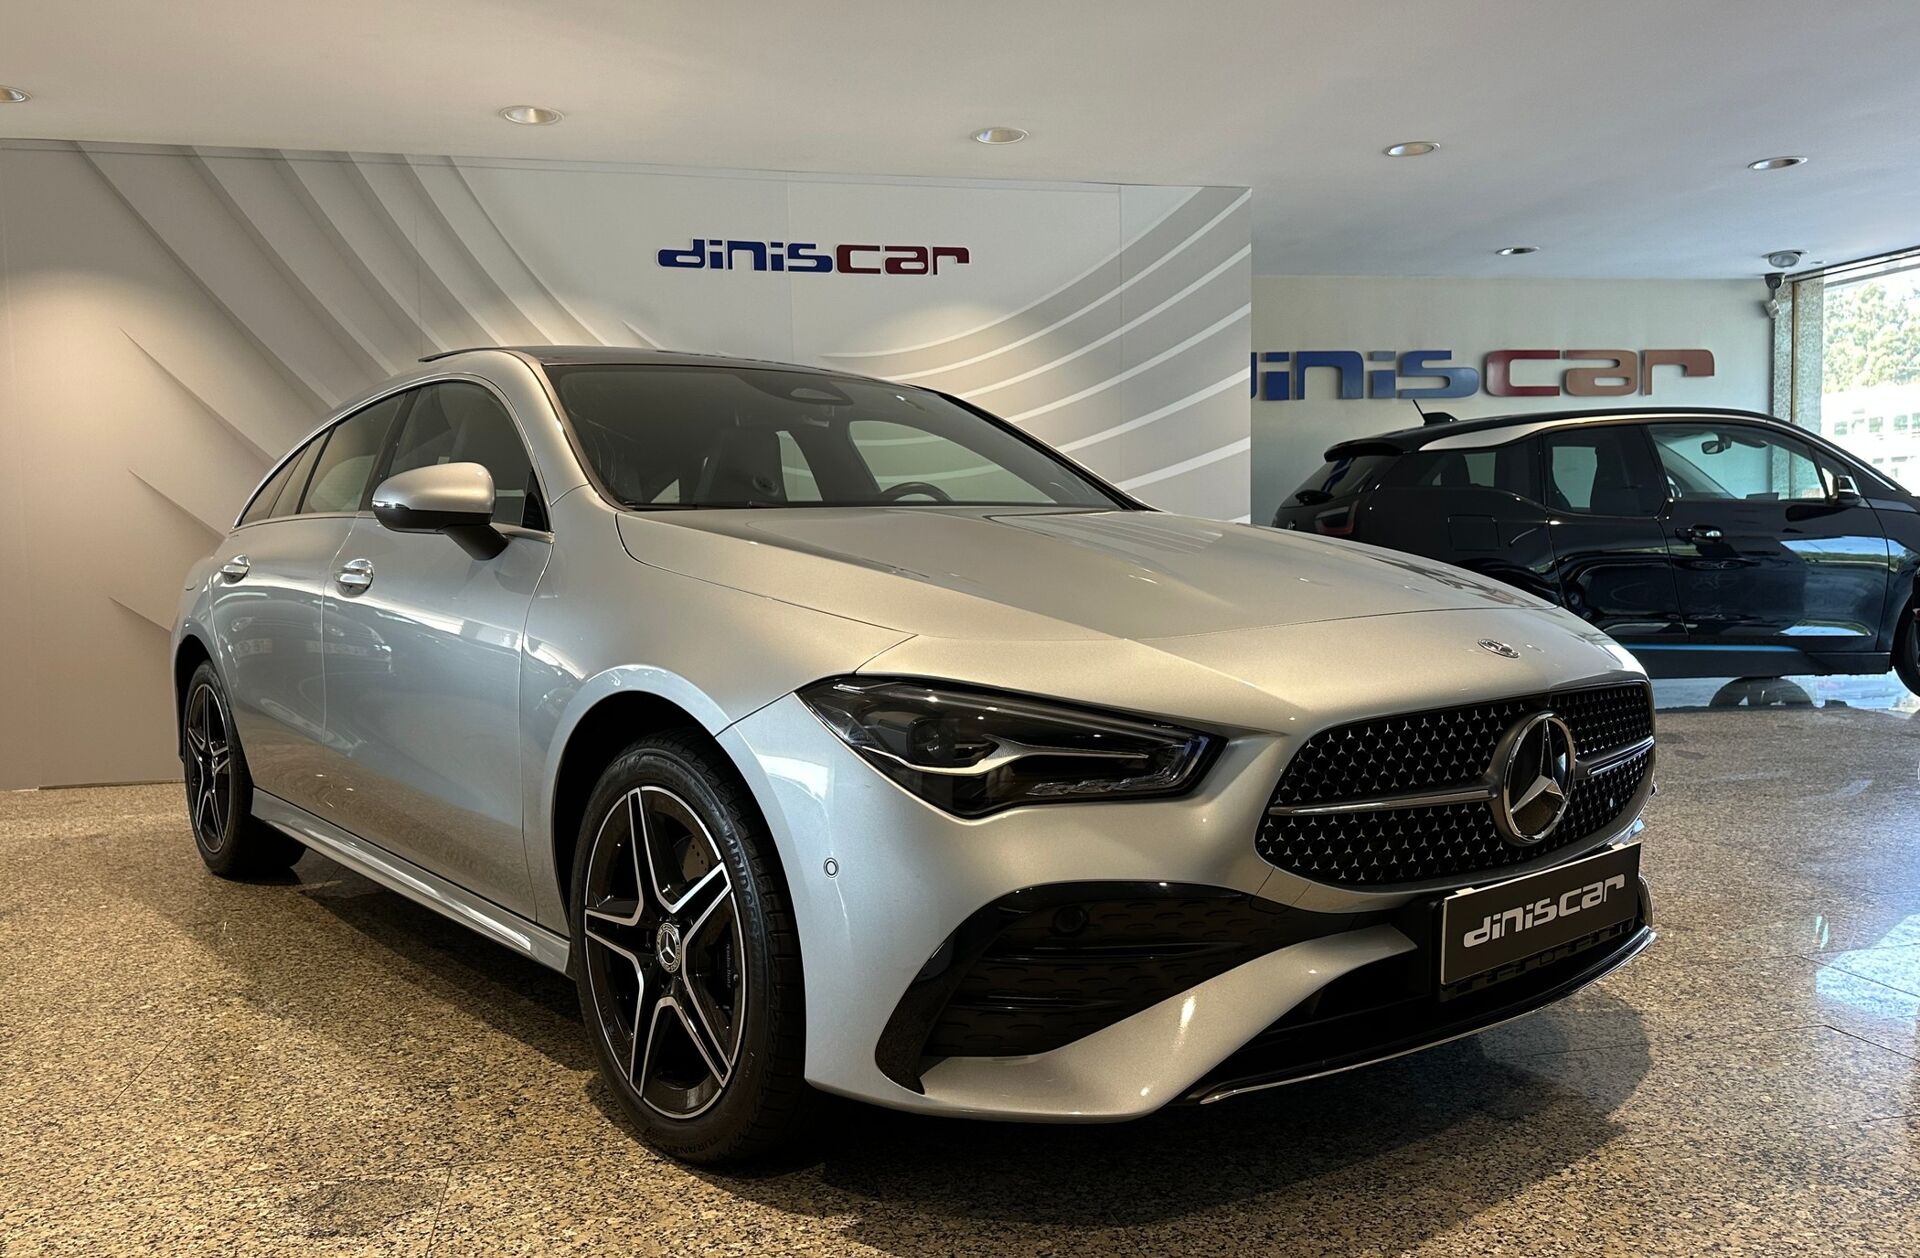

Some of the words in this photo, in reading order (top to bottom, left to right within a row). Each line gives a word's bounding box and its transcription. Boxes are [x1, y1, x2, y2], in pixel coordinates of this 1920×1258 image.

[657, 238, 970, 275] diniscar
[1251, 349, 1715, 400] iniscar
[1464, 873, 1625, 948] diniscar
